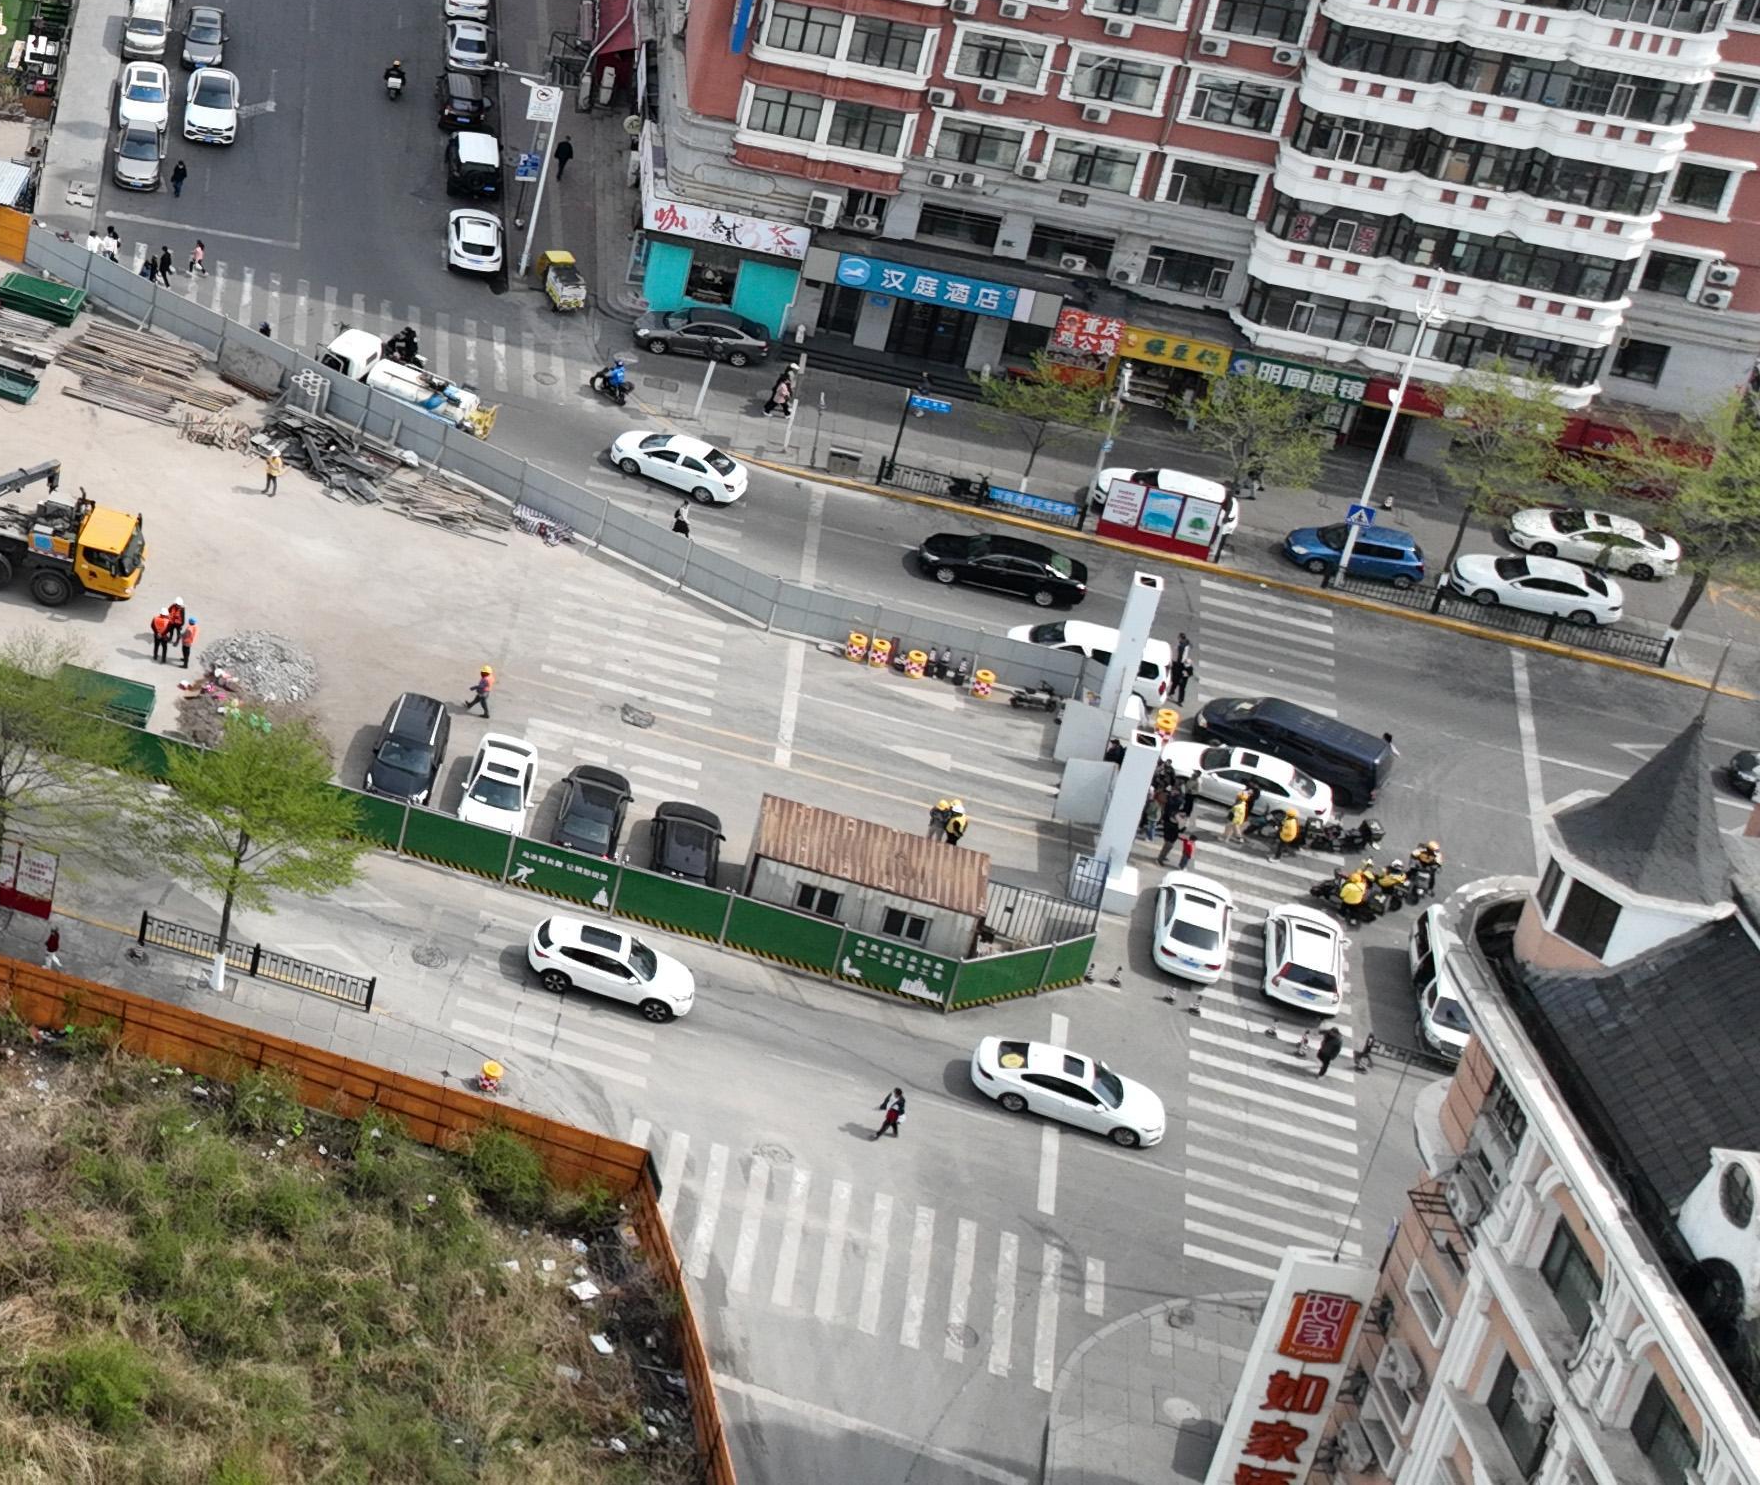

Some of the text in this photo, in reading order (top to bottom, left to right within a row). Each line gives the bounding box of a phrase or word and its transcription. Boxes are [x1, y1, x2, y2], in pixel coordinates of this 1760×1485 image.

[881, 268, 1006, 311] 汉庭酒店
[1081, 315, 1126, 339] 重庆
